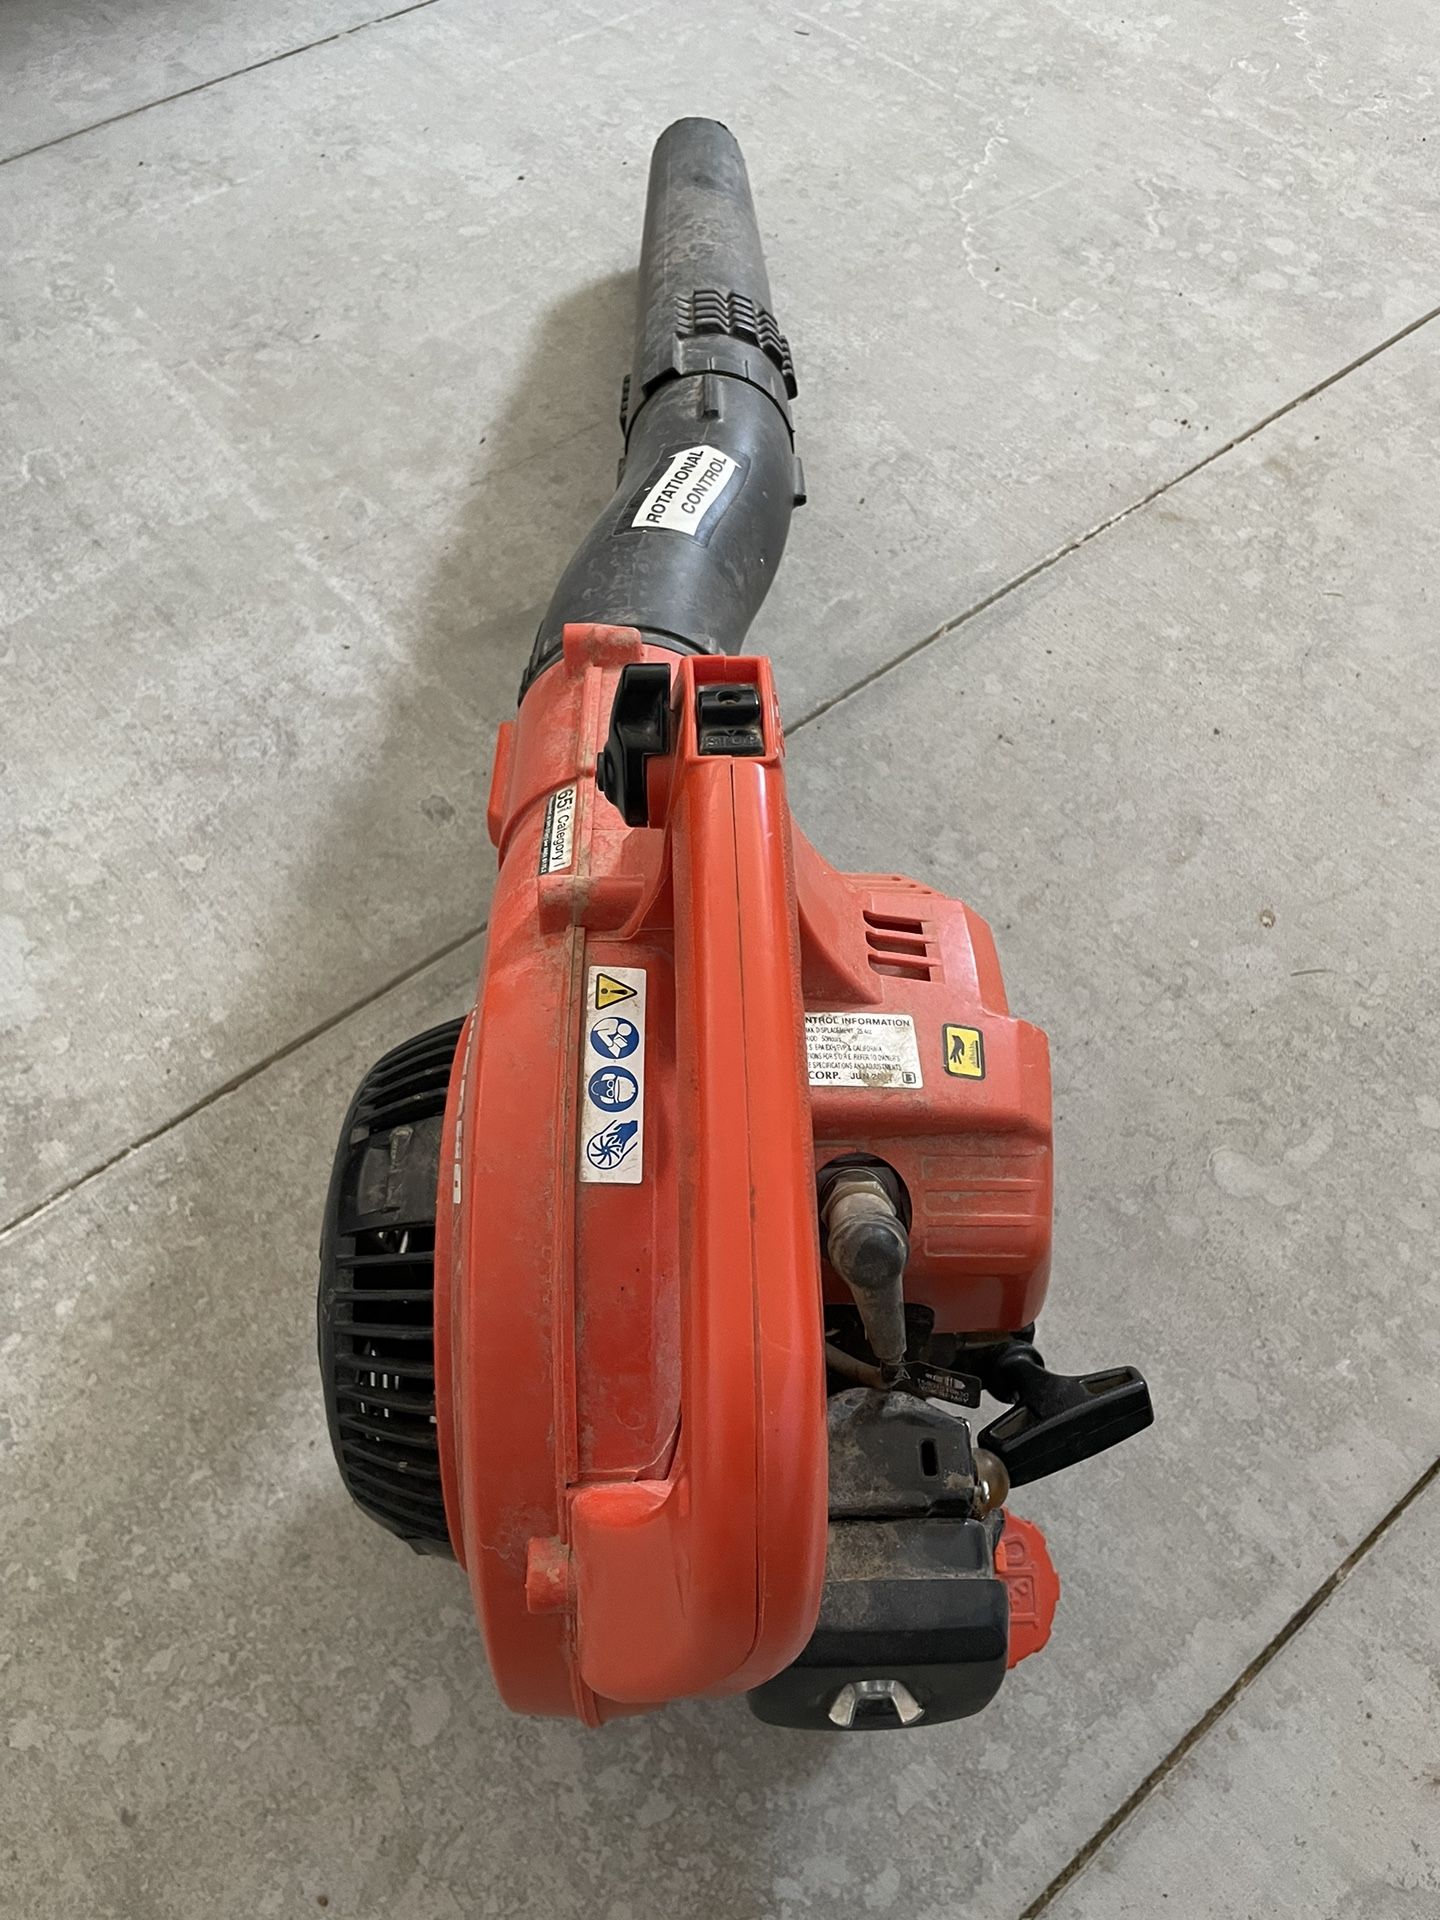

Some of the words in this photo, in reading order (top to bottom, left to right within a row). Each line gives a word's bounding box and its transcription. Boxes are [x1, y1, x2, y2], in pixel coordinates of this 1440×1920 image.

[646, 451, 704, 523] ROTATIONAL
[681, 458, 727, 514] CONTROL
[552, 815, 570, 861] Category
[841, 1017, 910, 1027] INFORMATION
[809, 1071, 841, 1079] CORP.
